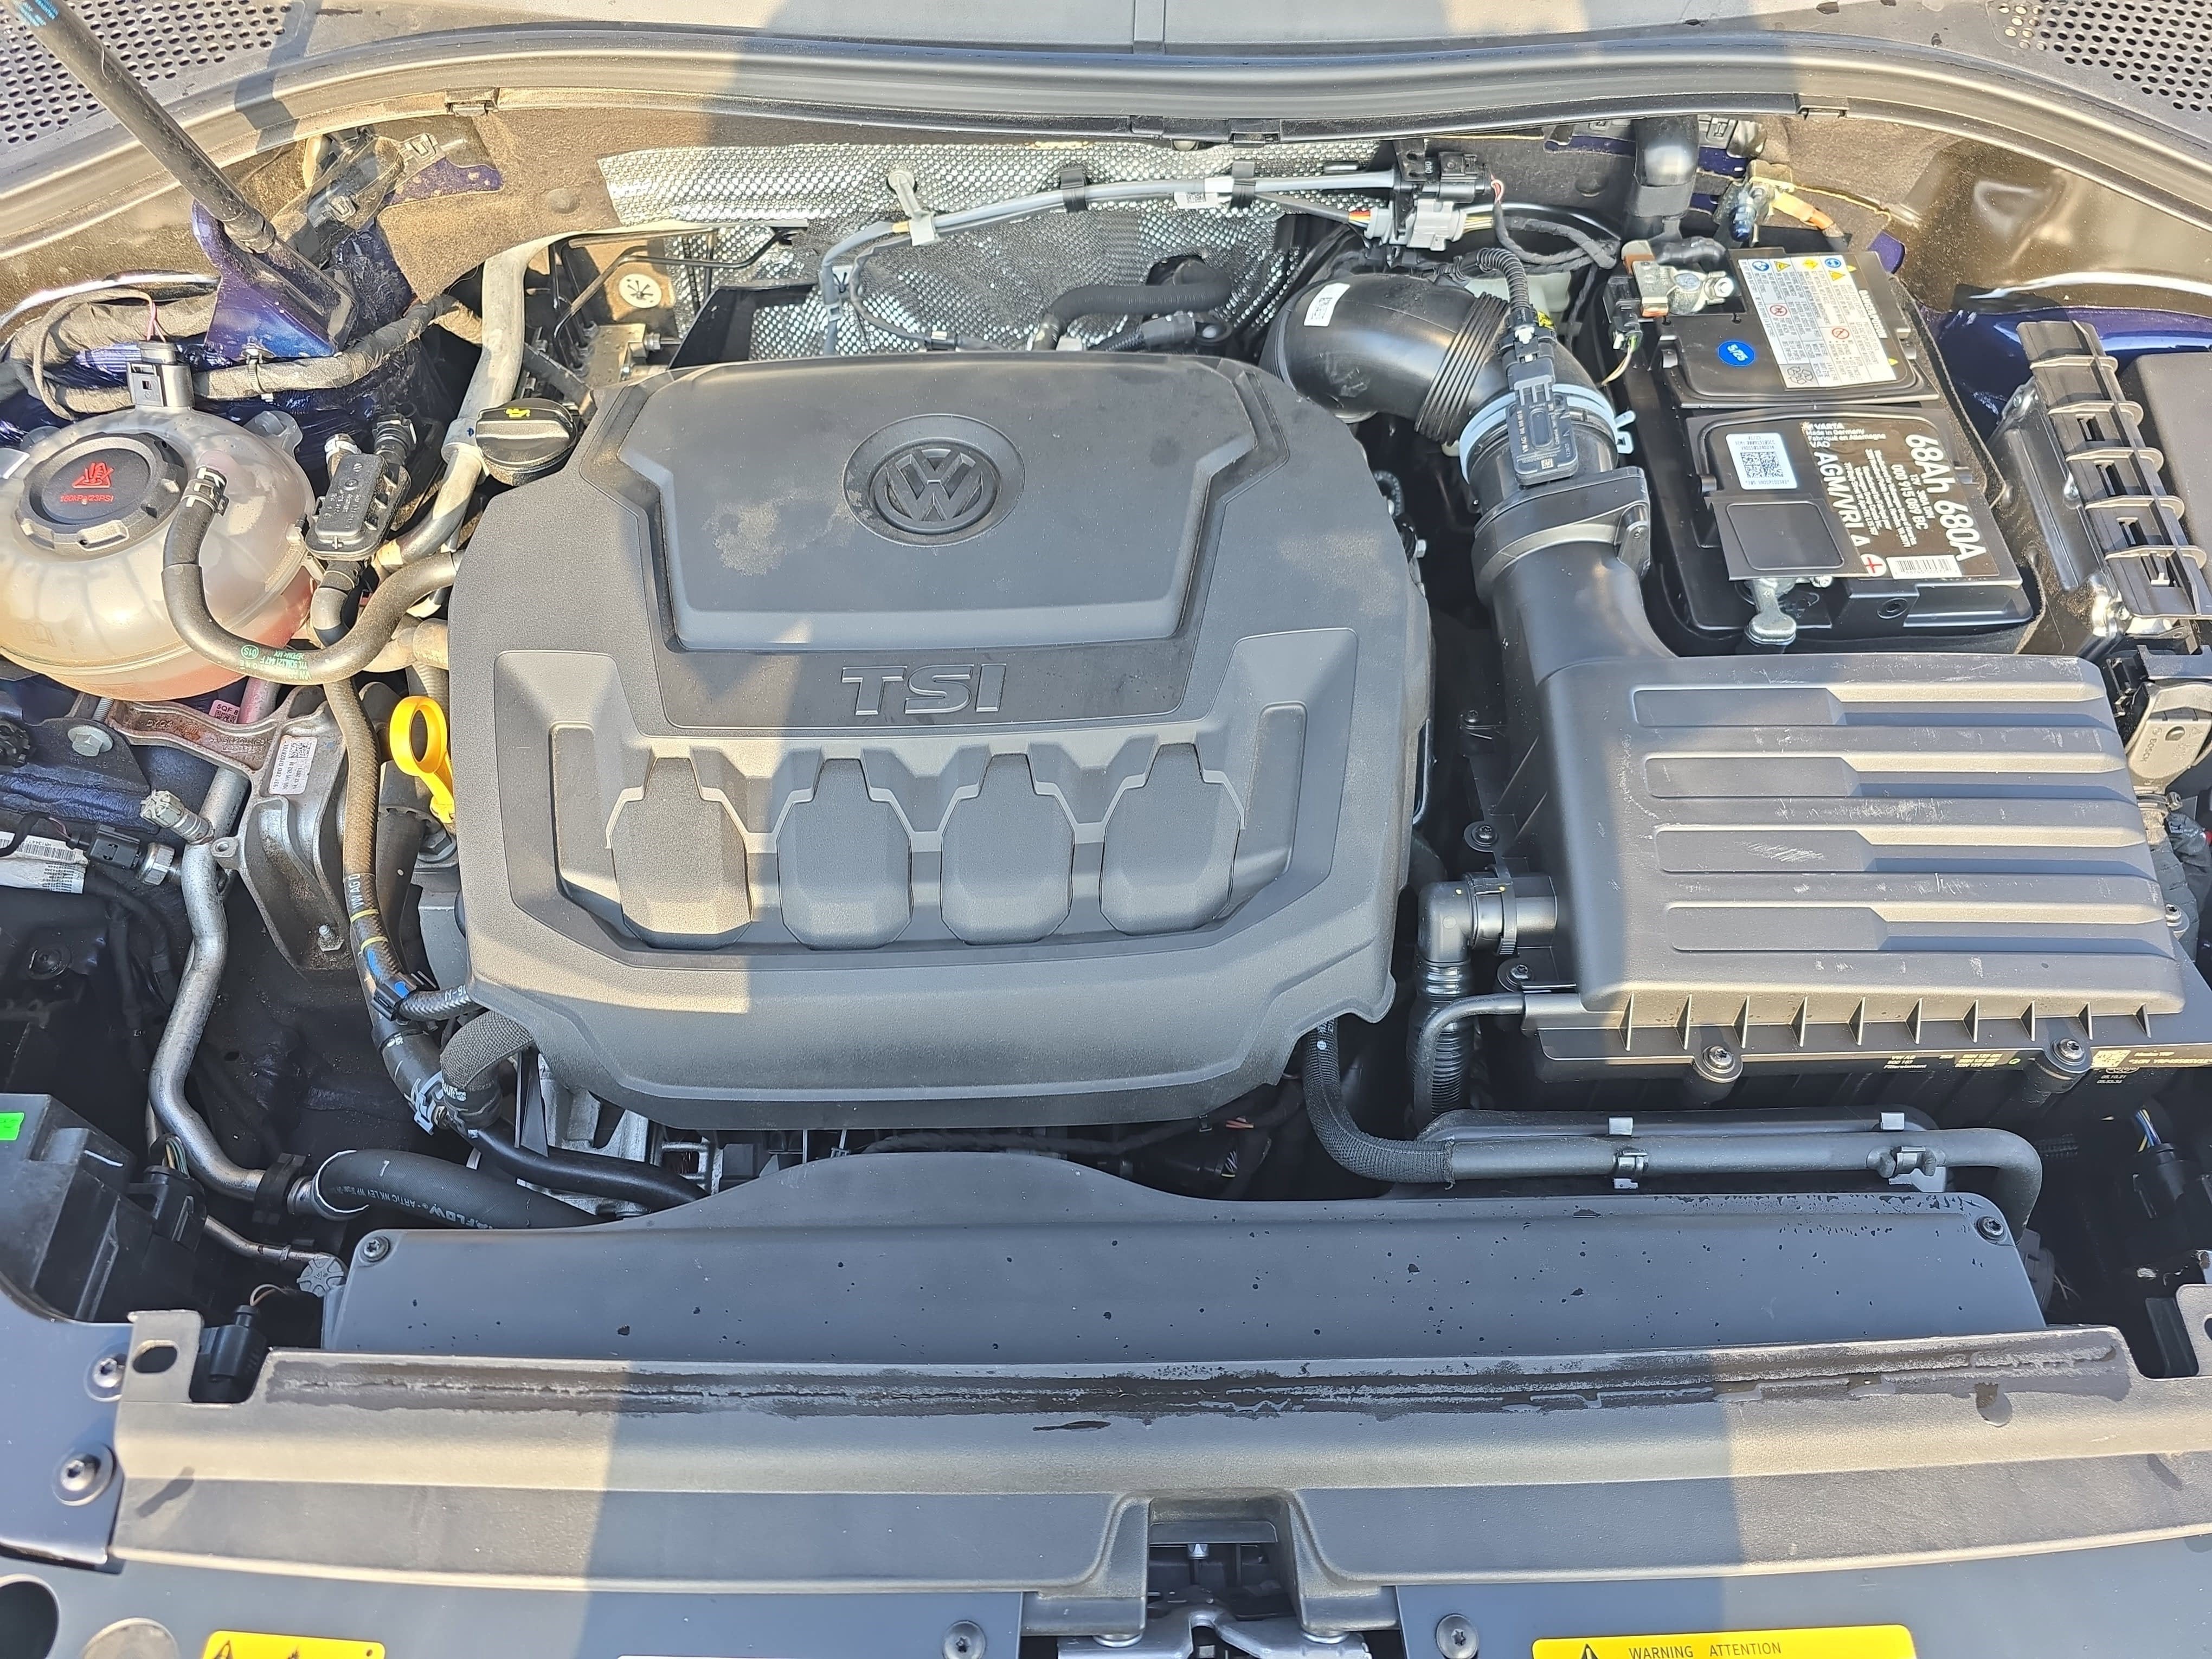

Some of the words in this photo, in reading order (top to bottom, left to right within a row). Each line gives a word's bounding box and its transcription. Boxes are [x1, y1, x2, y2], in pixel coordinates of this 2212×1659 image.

[1858, 290, 1888, 338] DANGER/POISON
[1891, 464, 1908, 480] 000
[1909, 474, 1922, 486] 12V
[1898, 481, 1916, 497] 915
[1905, 434, 1956, 493] 68Ah
[1933, 500, 1987, 562] 680A
[1916, 490, 1930, 506] 380A
[1905, 498, 1922, 515] 089
[1922, 506, 1935, 519] DIN
[1912, 515, 1929, 530] BC
[841, 663, 1007, 716] TSI
[216, 703, 233, 712] 5QF
[348, 882, 361, 893] AG
[380, 1191, 390, 1201] NK
[391, 1194, 415, 1208] ARTIC
[1629, 1645, 1694, 1659] WARNING
[1709, 1642, 1782, 1657] ATTENTION
